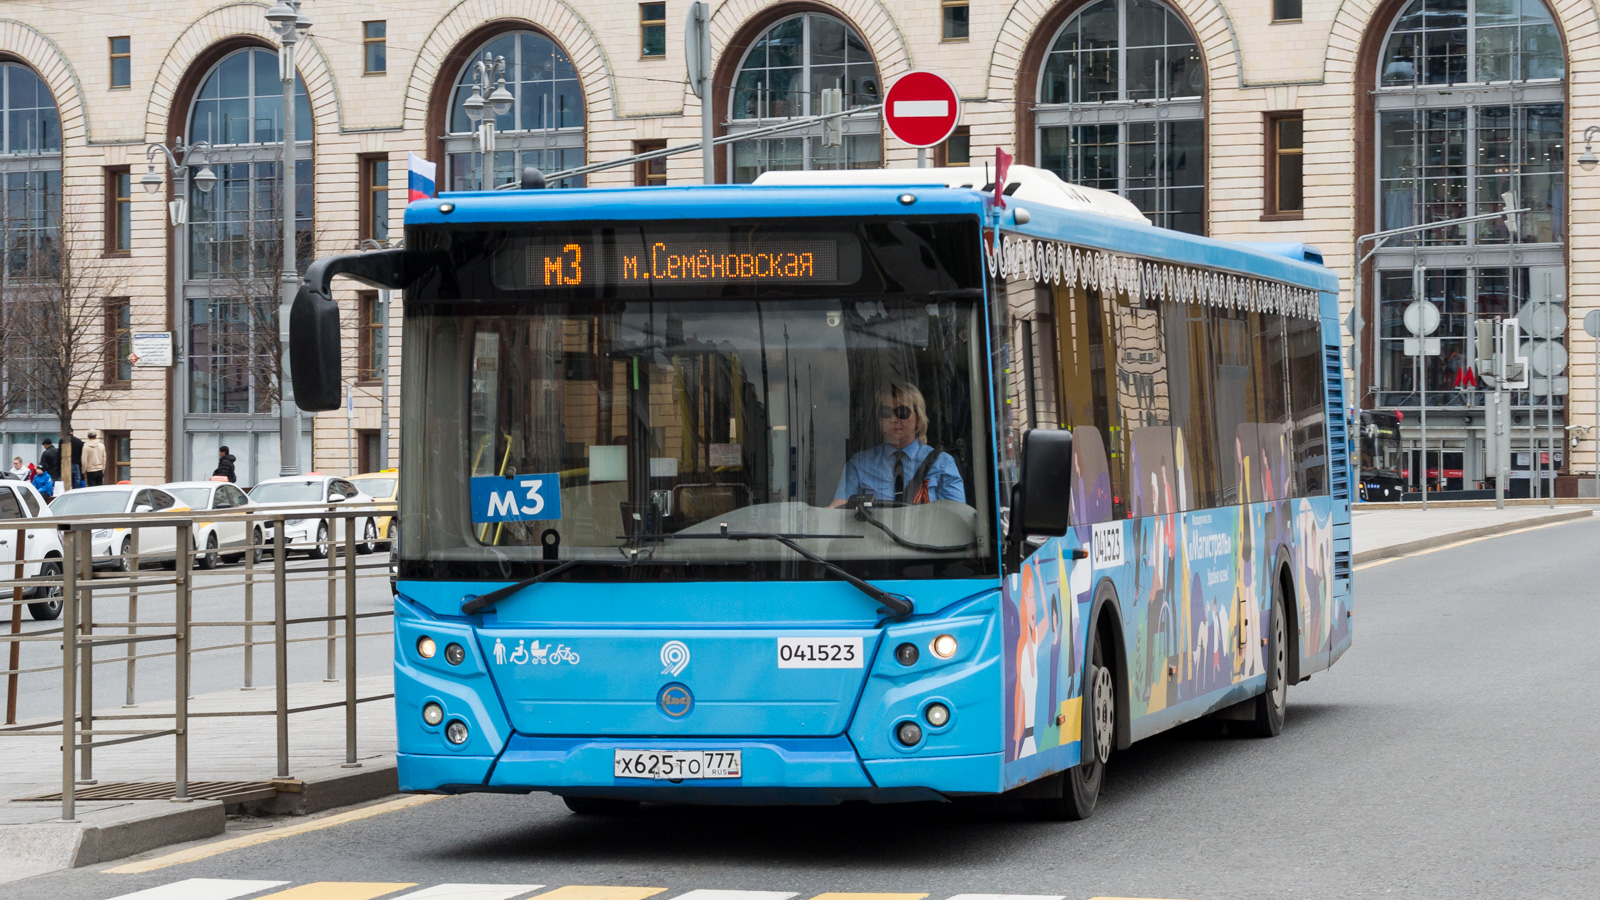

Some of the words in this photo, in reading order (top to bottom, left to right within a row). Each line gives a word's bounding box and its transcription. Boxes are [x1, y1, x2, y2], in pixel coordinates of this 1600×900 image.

[545, 243, 582, 285] м3
[624, 242, 813, 280] м.Семёновская
[487, 479, 545, 517] м3
[1094, 528, 1120, 563] 041523
[780, 644, 855, 662] 041523
[704, 752, 735, 769] 777
